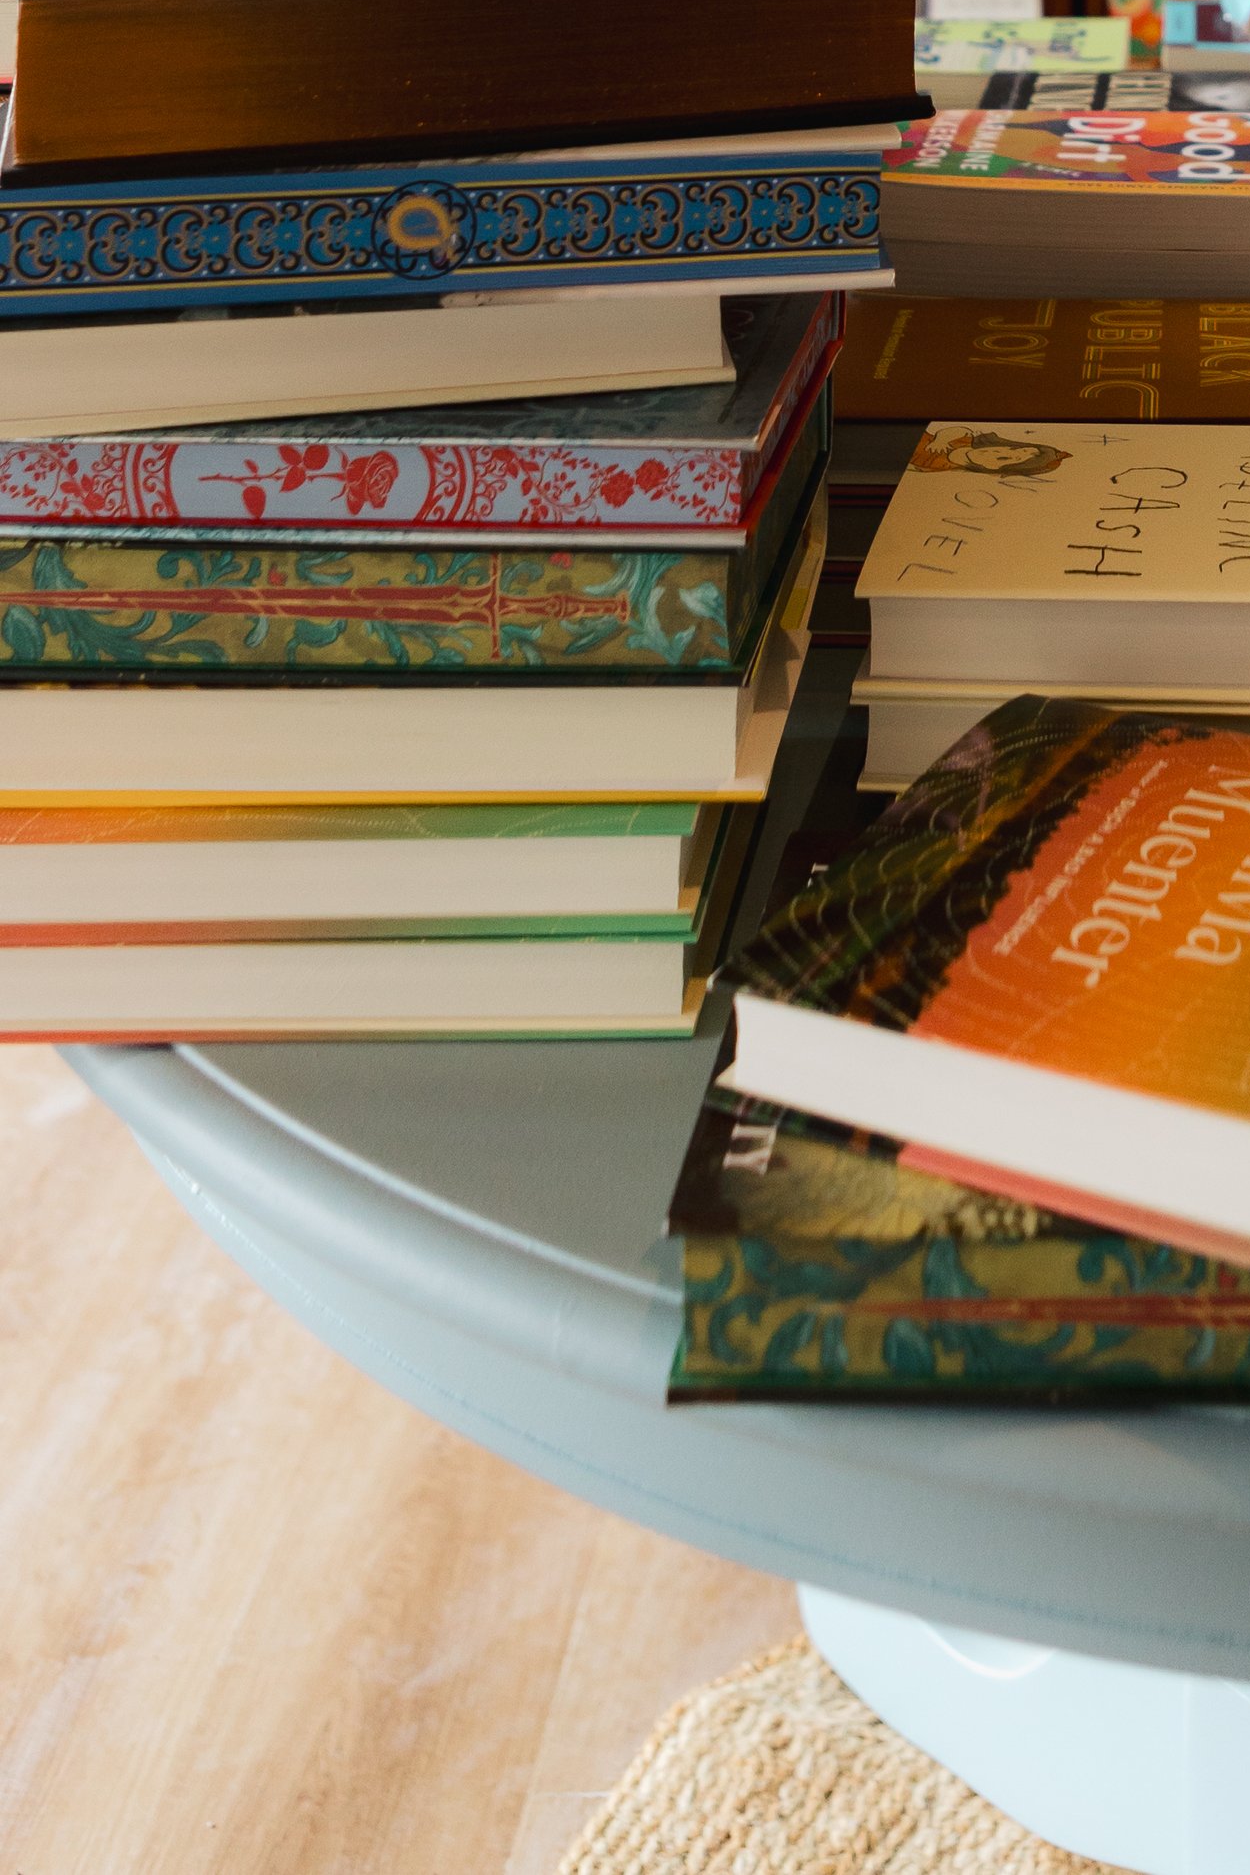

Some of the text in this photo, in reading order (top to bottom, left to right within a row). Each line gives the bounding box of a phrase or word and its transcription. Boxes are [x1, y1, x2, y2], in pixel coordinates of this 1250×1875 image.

[1055, 115, 1146, 165] Dirt
[967, 298, 1056, 369] JOY
[1079, 299, 1164, 421] PUBLIC
[1096, 432, 1130, 448] A
[896, 472, 1058, 585] NOVEL
[1063, 464, 1189, 581] CASH
